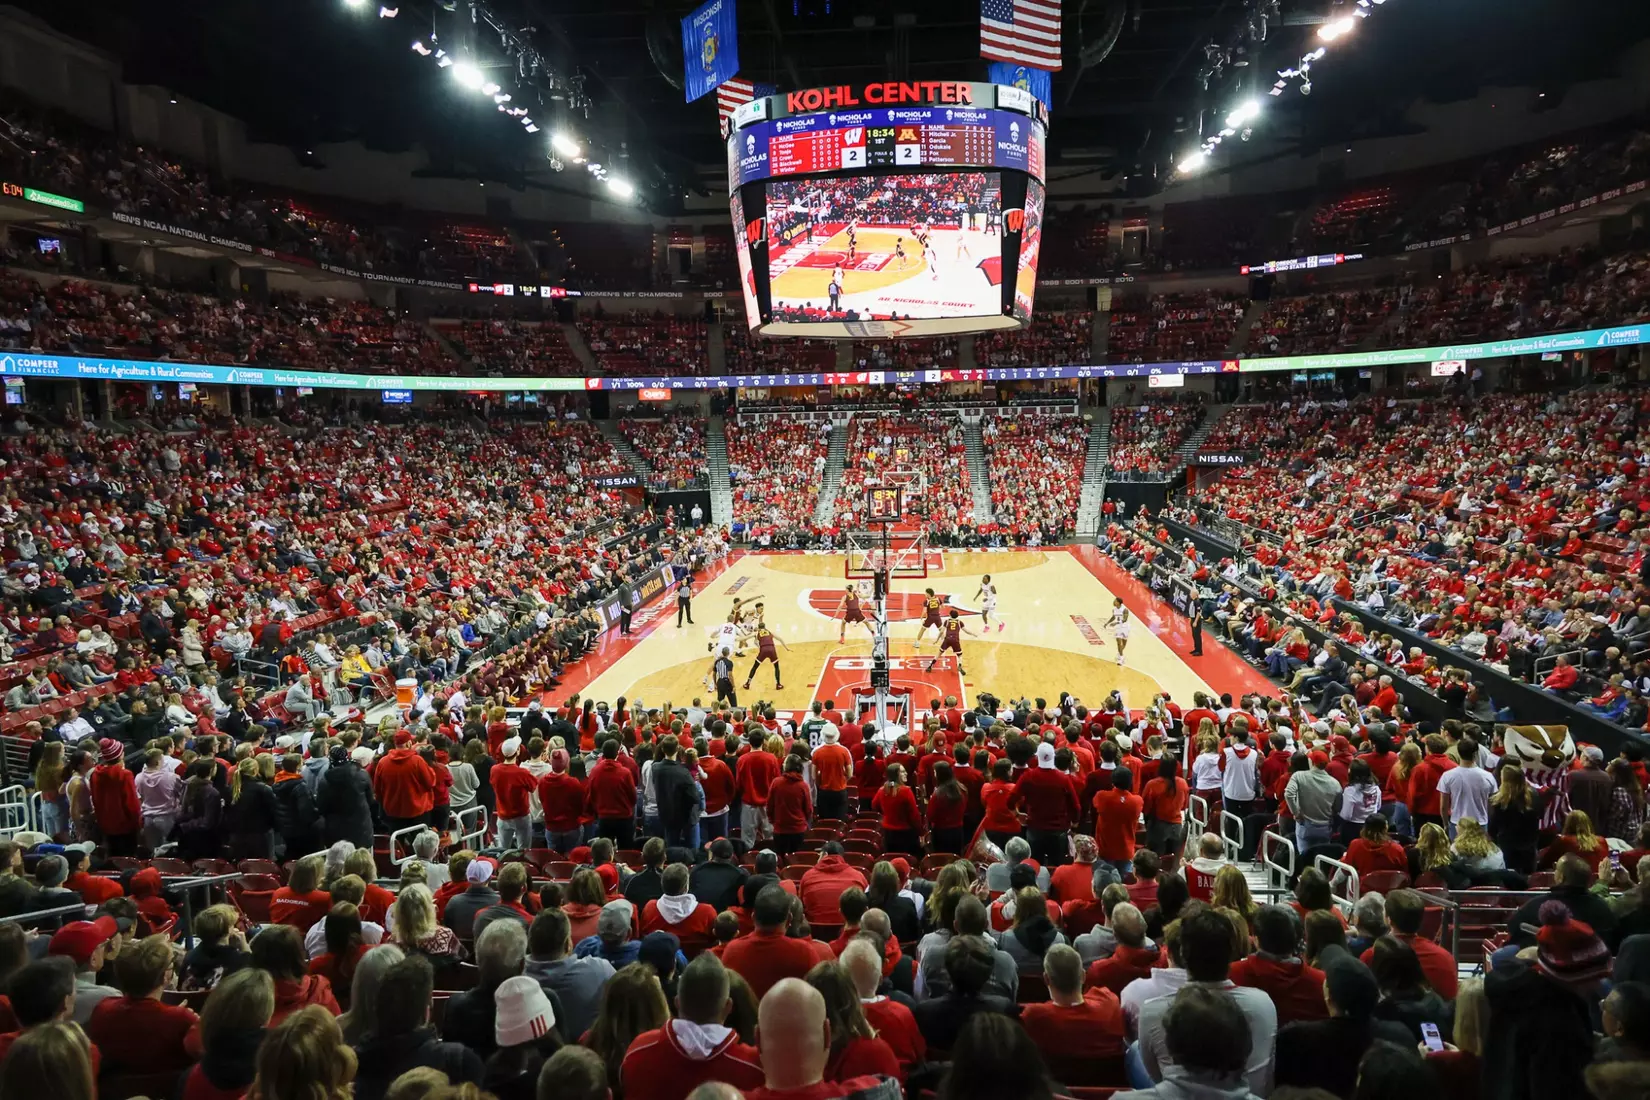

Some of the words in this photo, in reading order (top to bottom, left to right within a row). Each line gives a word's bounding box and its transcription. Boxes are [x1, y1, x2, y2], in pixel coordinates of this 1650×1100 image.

[694, 1, 722, 28] WISCONSIN
[787, 85, 859, 112] KOHL
[864, 81, 972, 104] CENTER
[837, 113, 872, 122] NICHOLAS
[783, 118, 815, 129] NICHOLAS
[867, 129, 895, 138] 18:34
[904, 148, 912, 158] 2
[998, 142, 1027, 154] NICHOLAS
[740, 153, 767, 167] NICHOLAS
[849, 151, 857, 161] 2
[779, 159, 802, 167] Blackwell
[3, 183, 23, 197] 6:04
[35, 192, 79, 210] AssociatedBank
[112, 212, 141, 226] MEN'S
[143, 219, 168, 232] NCAA
[169, 225, 208, 242] NATIONAL
[210, 235, 253, 252] CHAMPIONS
[1405, 241, 1429, 251] MEN'S
[1430, 236, 1457, 247] SWEET
[1289, 262, 1306, 270] STATE
[330, 265, 345, 274] MEN'S
[346, 269, 360, 277] NCAA
[363, 272, 415, 284] TOURNAMENT
[417, 279, 463, 290] APPEARANCES
[893, 297, 938, 305] NICHOLAS
[942, 301, 976, 309] COURT
[1611, 330, 1640, 339] COMPEER
[1552, 337, 1585, 347] Communities
[17, 359, 58, 368] COMPEER
[78, 363, 97, 373] Here
[98, 365, 109, 374] for
[111, 365, 149, 378] Agriculture
[150, 367, 156, 375] &
[158, 368, 174, 376] Rural
[175, 368, 214, 379] Communities
[274, 373, 286, 382] Here
[1199, 455, 1243, 463] NISSAN
[594, 477, 636, 486] NISSAN
[874, 490, 897, 499] 18:34
[929, 601, 938, 609] 25
[724, 626, 733, 634] 22
[276, 898, 309, 906] BADGERS
